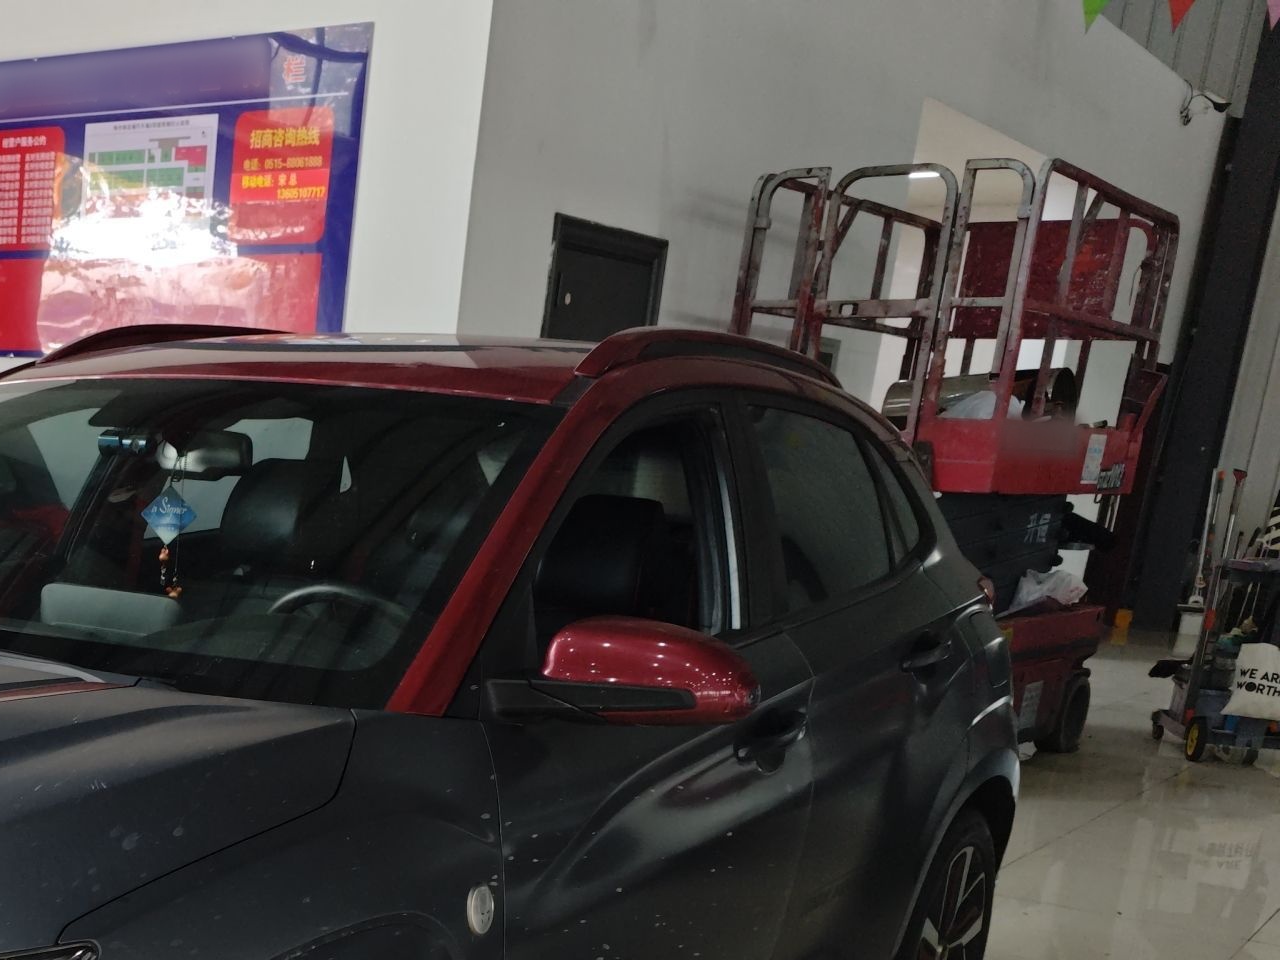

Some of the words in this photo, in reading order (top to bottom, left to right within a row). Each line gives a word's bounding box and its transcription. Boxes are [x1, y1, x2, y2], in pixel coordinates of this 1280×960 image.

[249, 126, 320, 149] 招商咨询热线
[1240, 668, 1258, 679] WE
[1260, 671, 1280, 684] AR
[1236, 681, 1280, 697] WORTH
